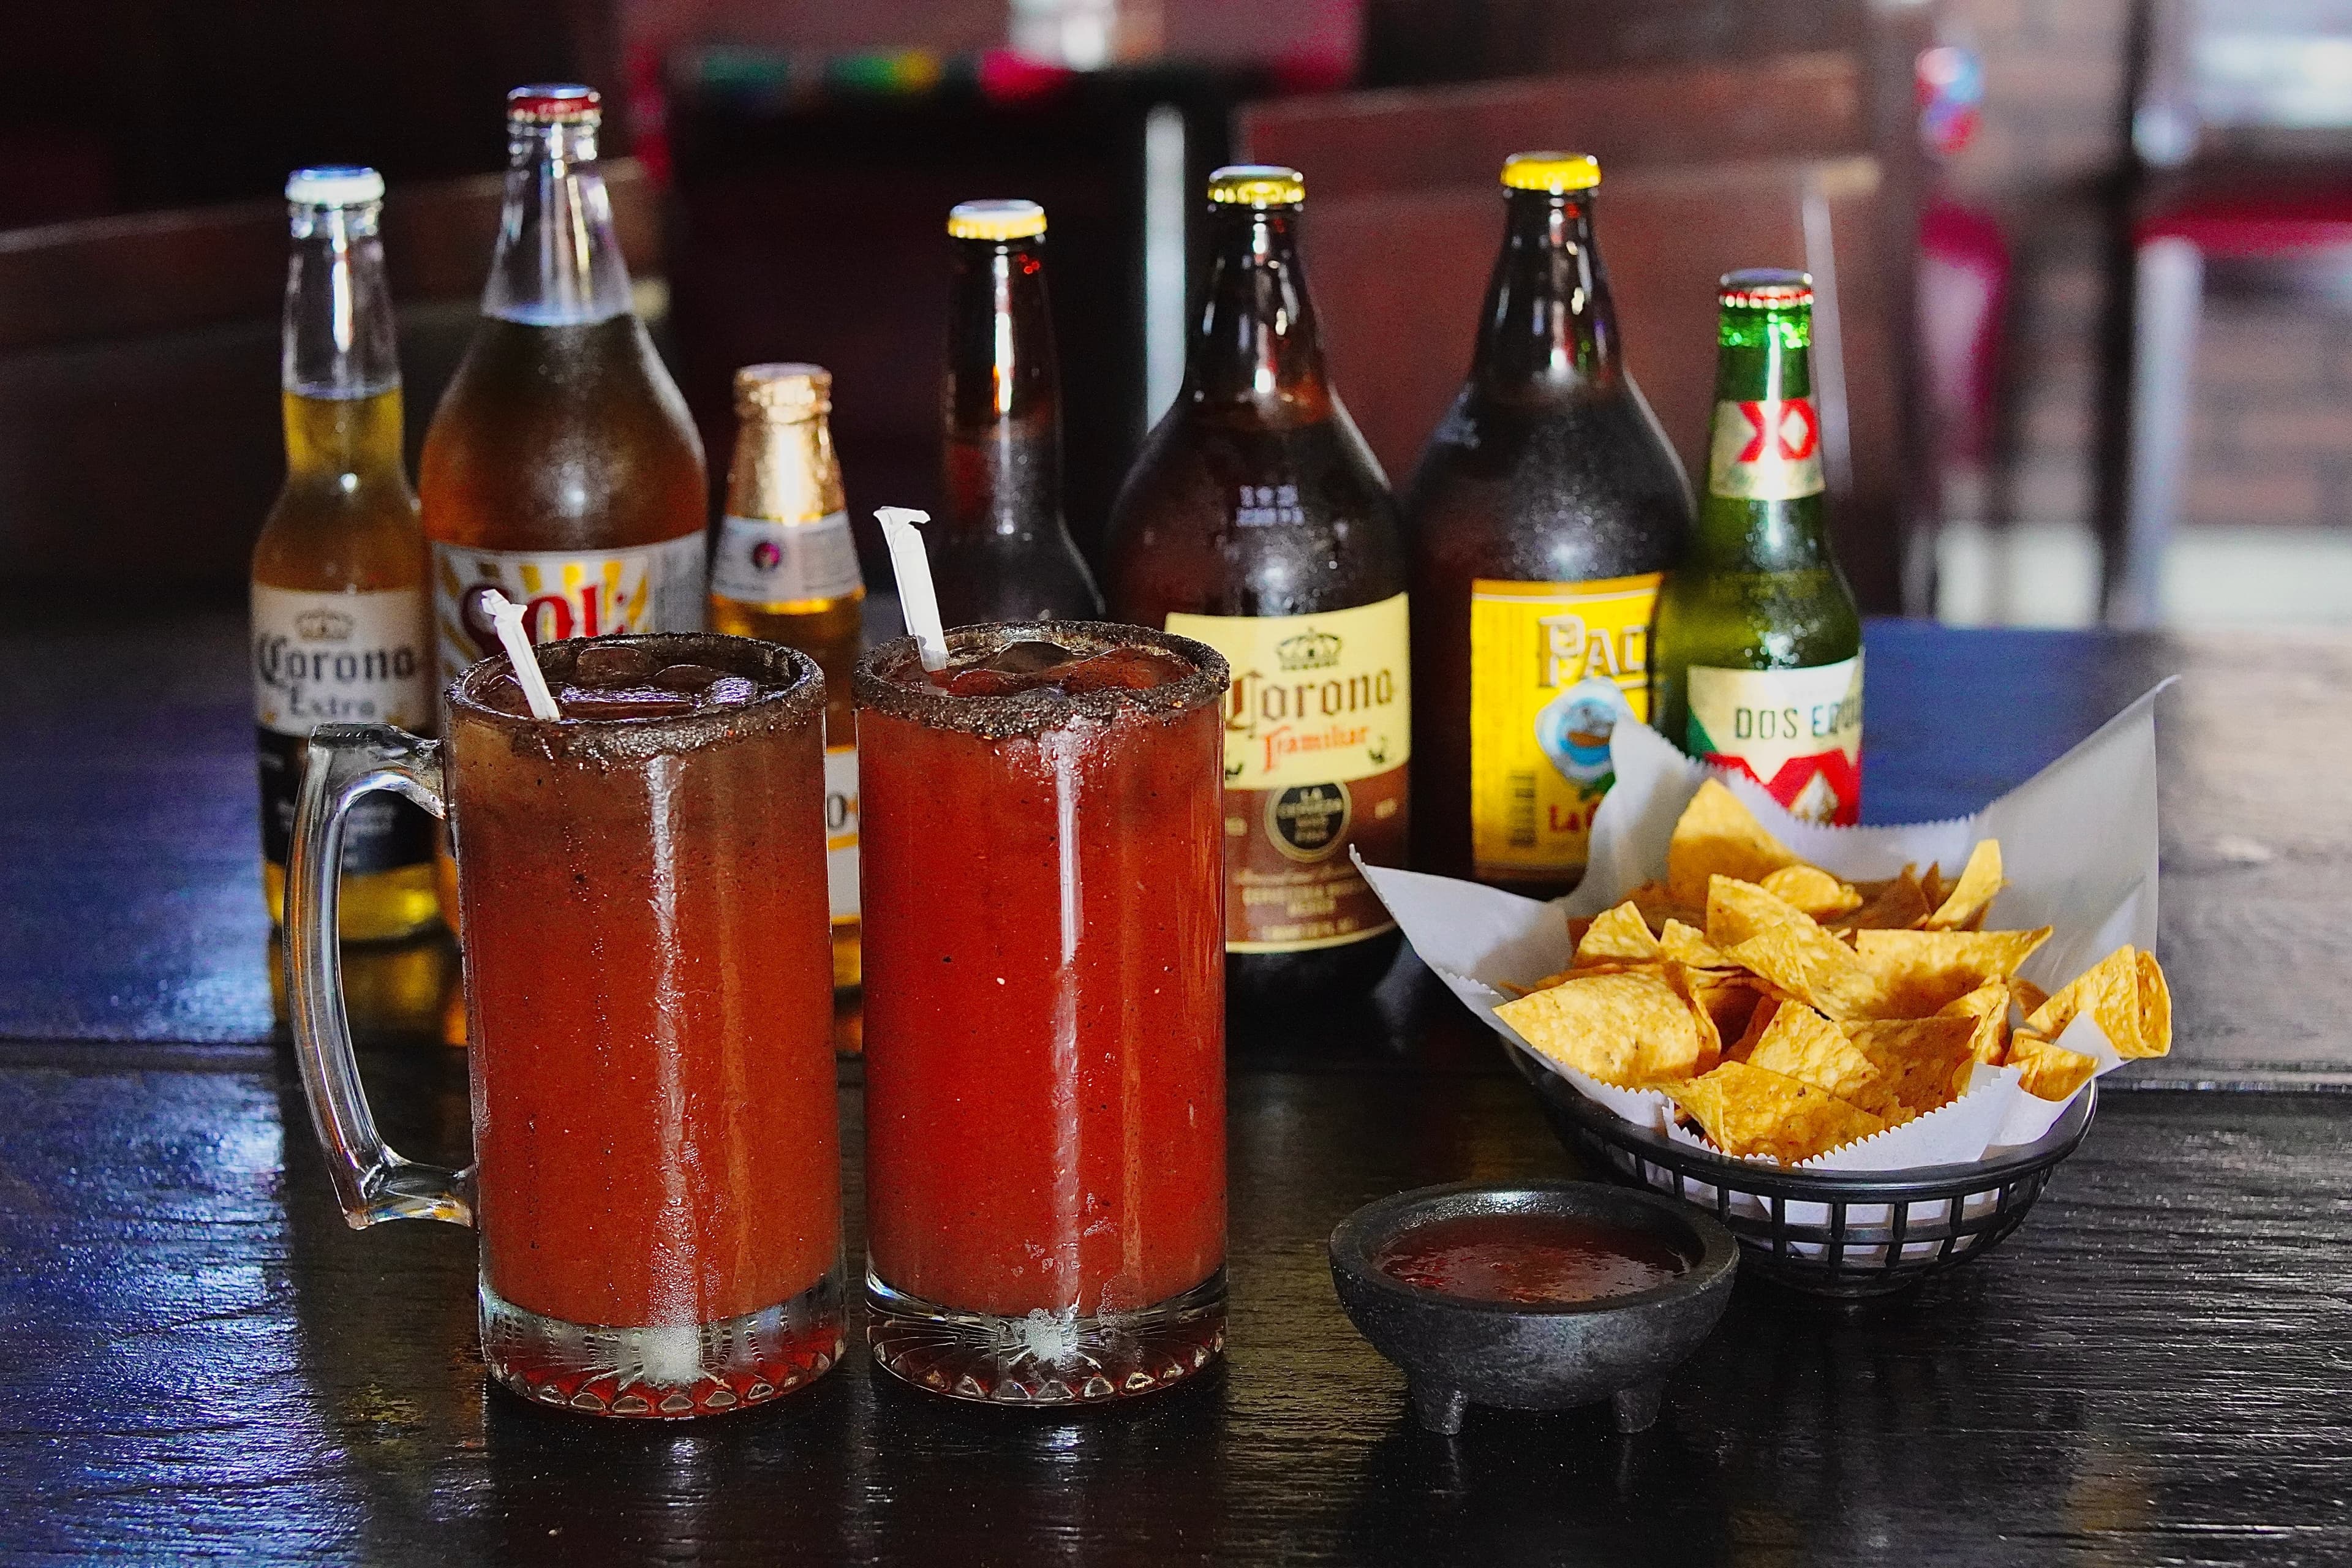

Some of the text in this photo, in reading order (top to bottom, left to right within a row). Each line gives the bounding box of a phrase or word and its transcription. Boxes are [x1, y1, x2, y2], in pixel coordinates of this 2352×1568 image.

[258, 633, 415, 690] Corona
[1225, 669, 1394, 737] Corona
[1735, 707, 1798, 739] DOS
